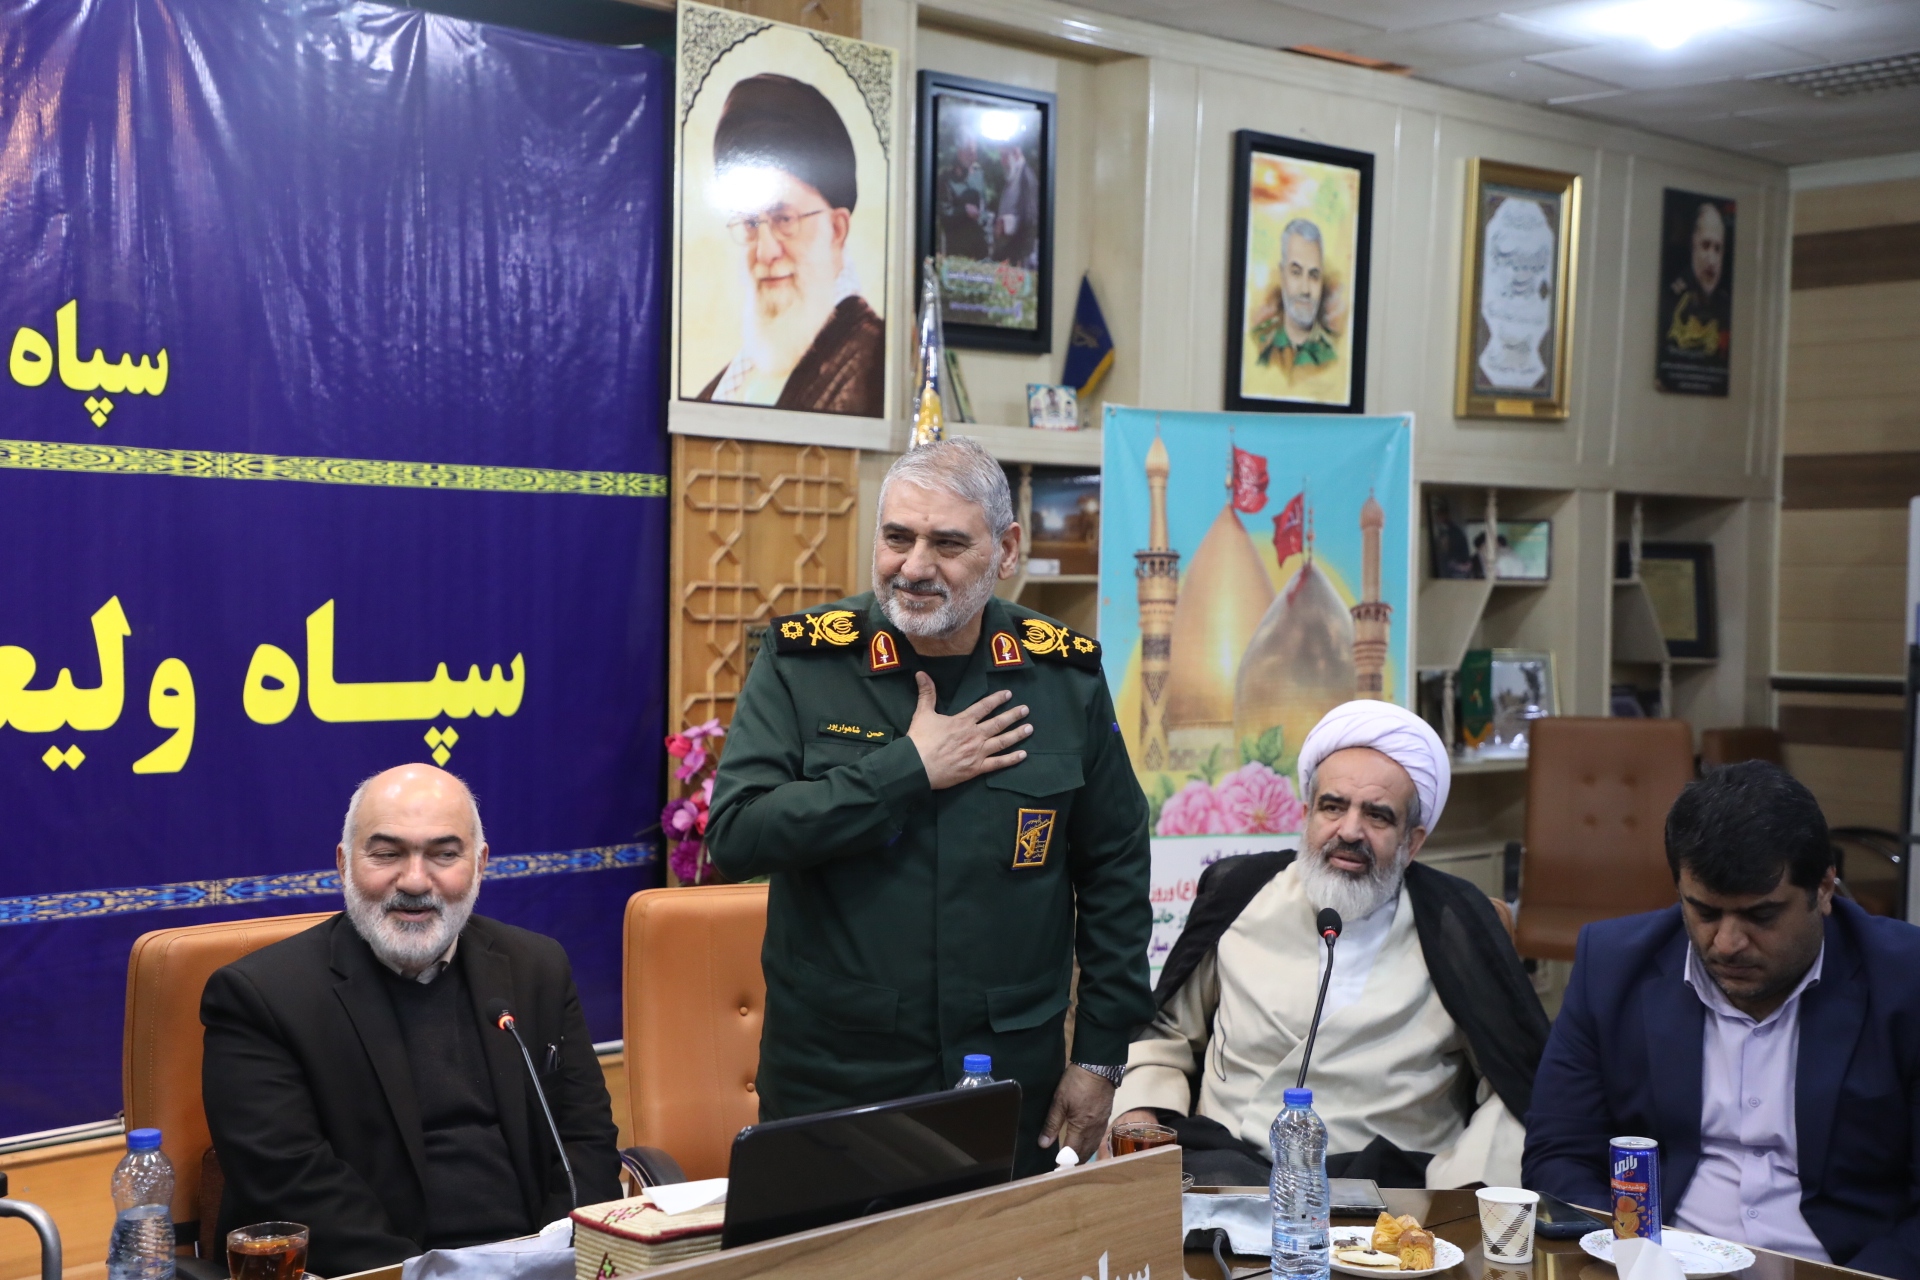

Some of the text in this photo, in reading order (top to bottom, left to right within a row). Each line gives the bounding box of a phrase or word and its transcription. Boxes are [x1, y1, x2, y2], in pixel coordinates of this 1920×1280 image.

[10, 300, 167, 426] سپاه
[243, 598, 525, 767] سپاه
[866, 730, 885, 738] حسن
[1614, 1154, 1638, 1176] رانی
